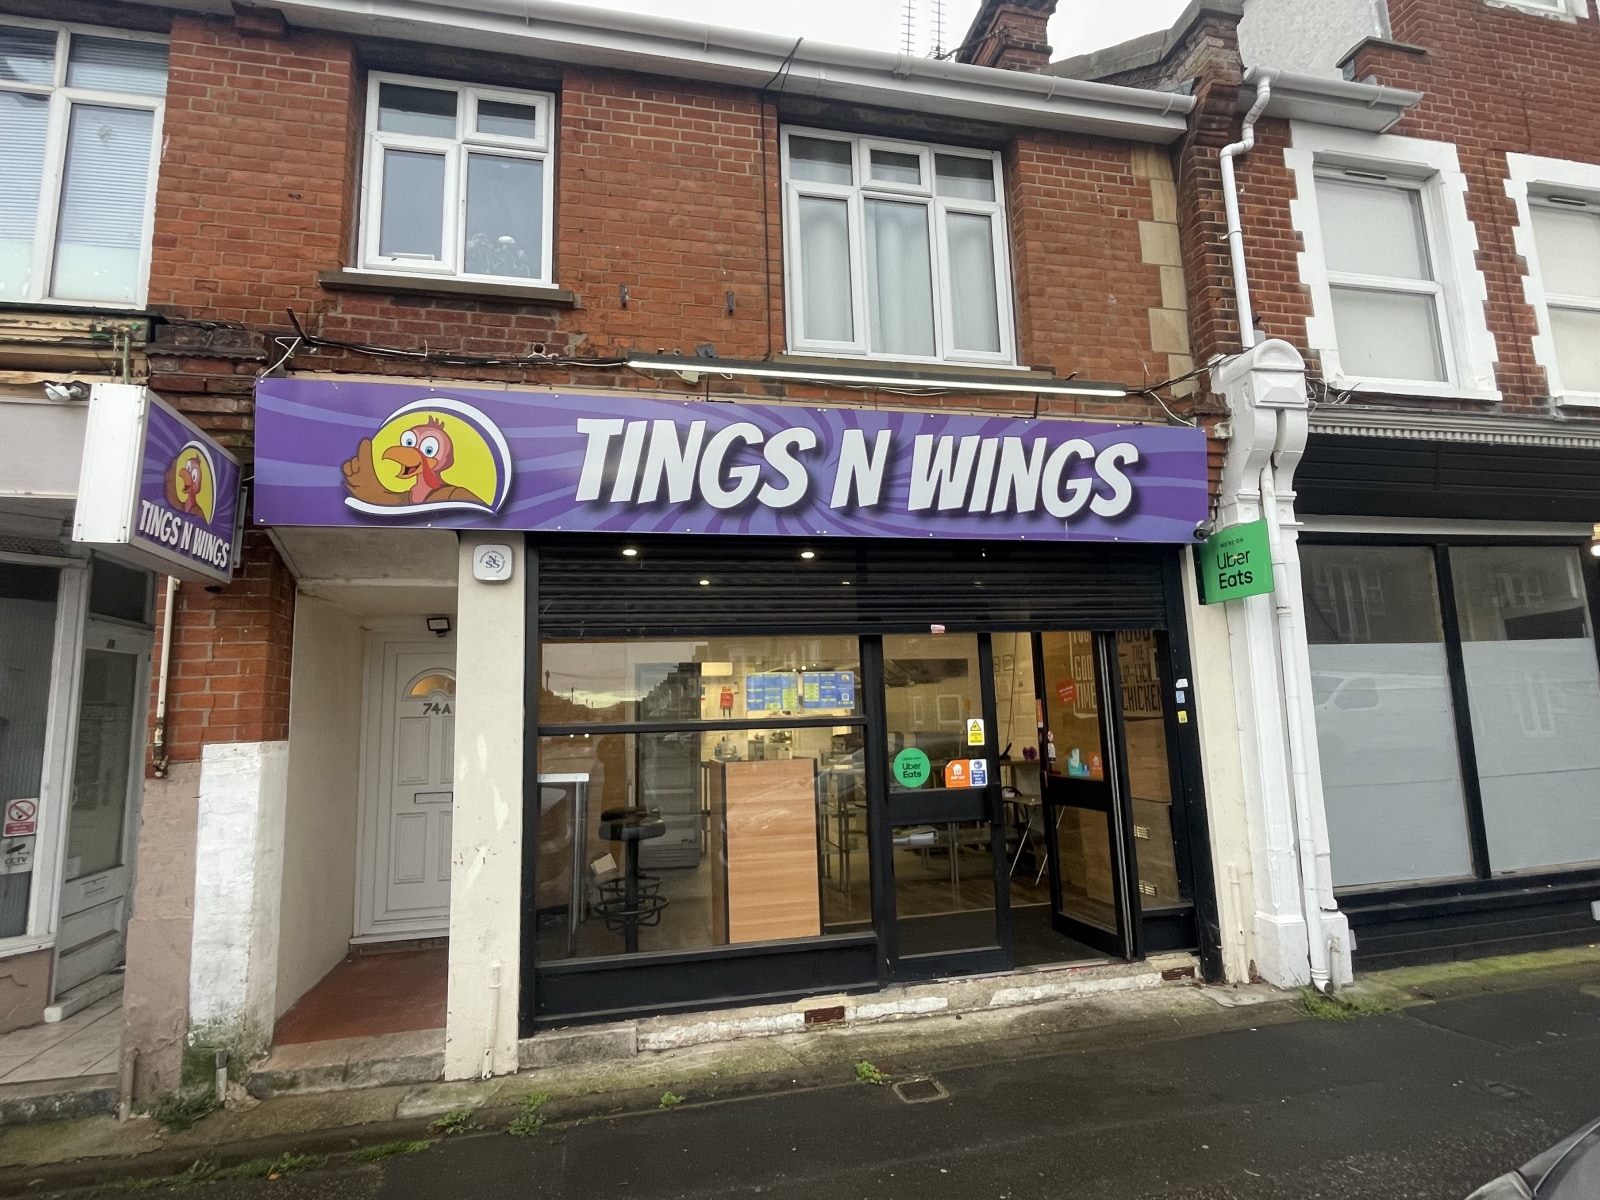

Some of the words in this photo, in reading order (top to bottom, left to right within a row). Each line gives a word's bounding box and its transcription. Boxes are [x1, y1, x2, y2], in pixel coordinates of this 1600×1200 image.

[576, 418, 816, 509] TINGS
[829, 429, 891, 509] N
[908, 434, 1139, 518] WINGS
[139, 499, 182, 546] TINGS
[180, 521, 194, 550] N
[192, 527, 230, 568] WINGS
[1217, 550, 1250, 570] Uber
[1218, 570, 1253, 590] Eats
[423, 702, 452, 716] 74A
[901, 763, 922, 771] Uber
[903, 771, 922, 779] Eats
[4, 856, 27, 865] CCTV
